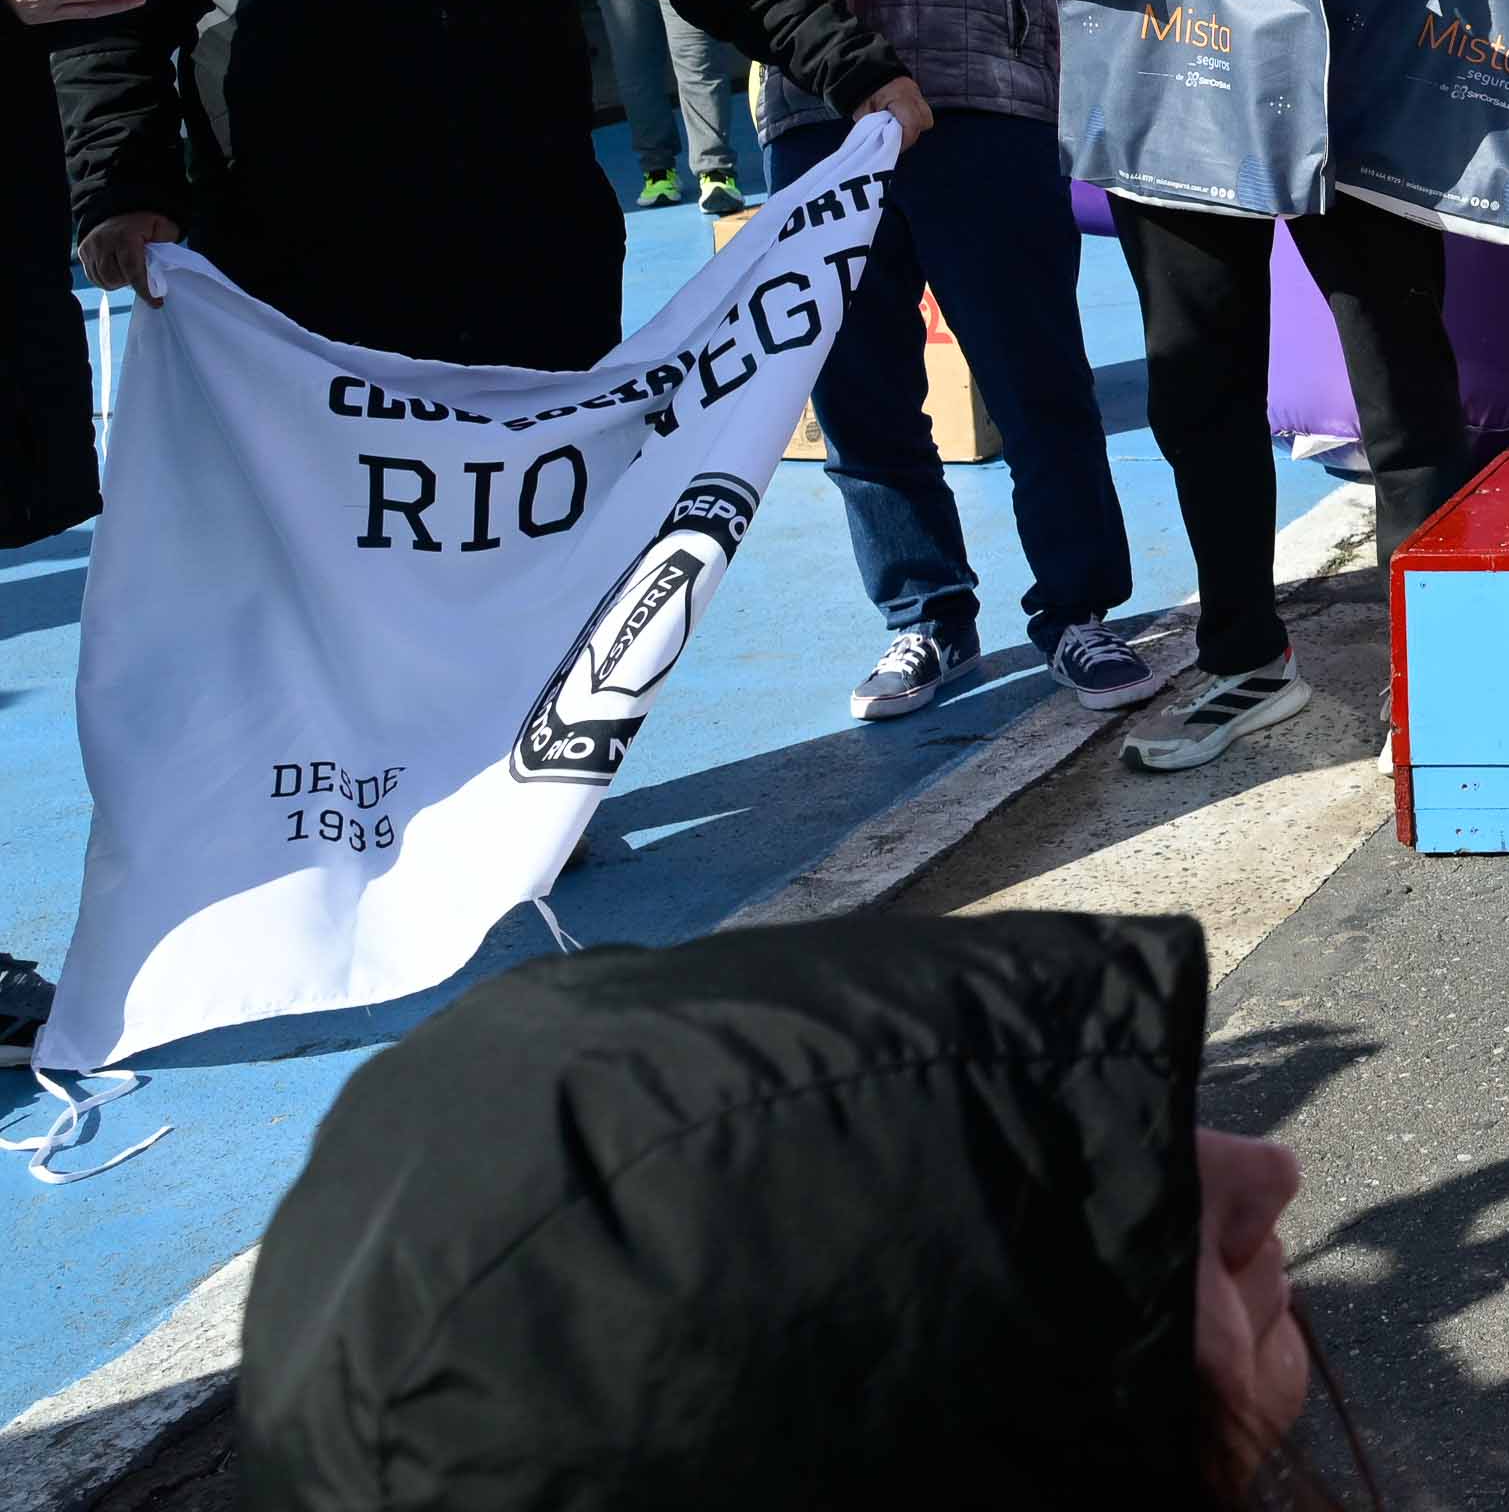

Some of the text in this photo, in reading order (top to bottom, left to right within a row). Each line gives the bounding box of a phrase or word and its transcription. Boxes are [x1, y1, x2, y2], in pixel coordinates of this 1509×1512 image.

[1141, 2, 1232, 54] Mista
[357, 443, 589, 554] RIO
[270, 761, 408, 810] DESDE
[287, 809, 396, 853] 1939
